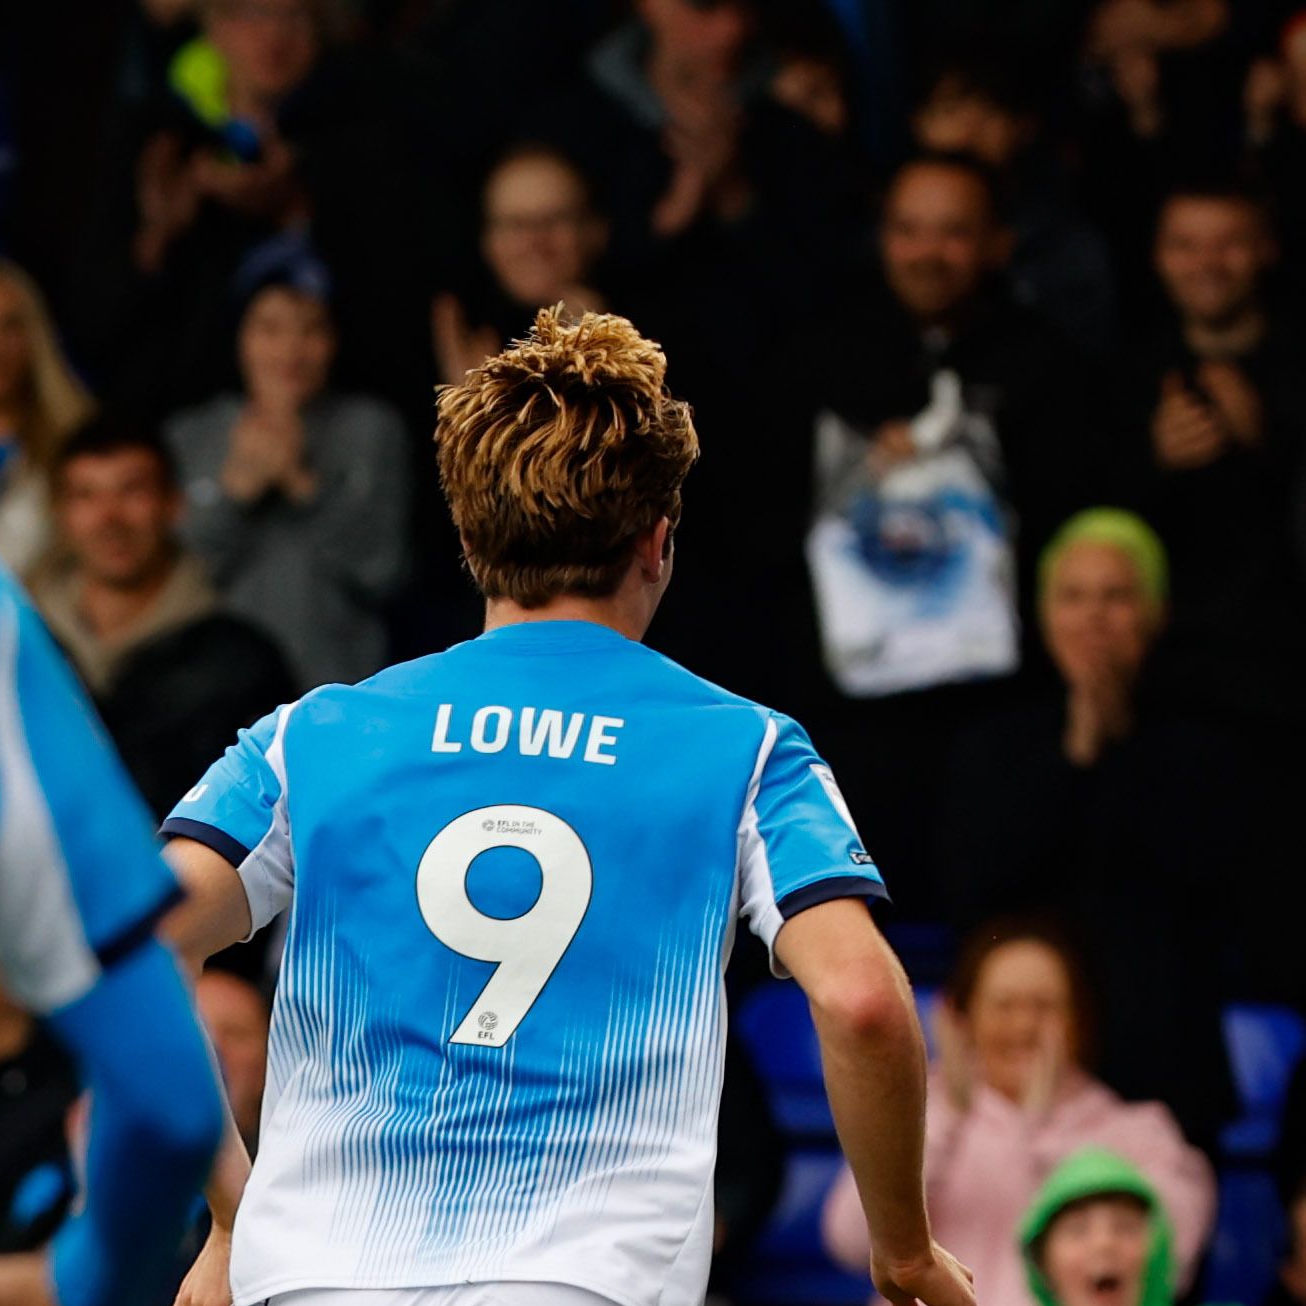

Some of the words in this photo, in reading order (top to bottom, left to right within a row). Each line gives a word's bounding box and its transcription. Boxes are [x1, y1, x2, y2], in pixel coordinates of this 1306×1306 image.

[430, 703, 625, 766] LOWE
[415, 803, 594, 1049] 9
[477, 1030, 495, 1040] EFL
